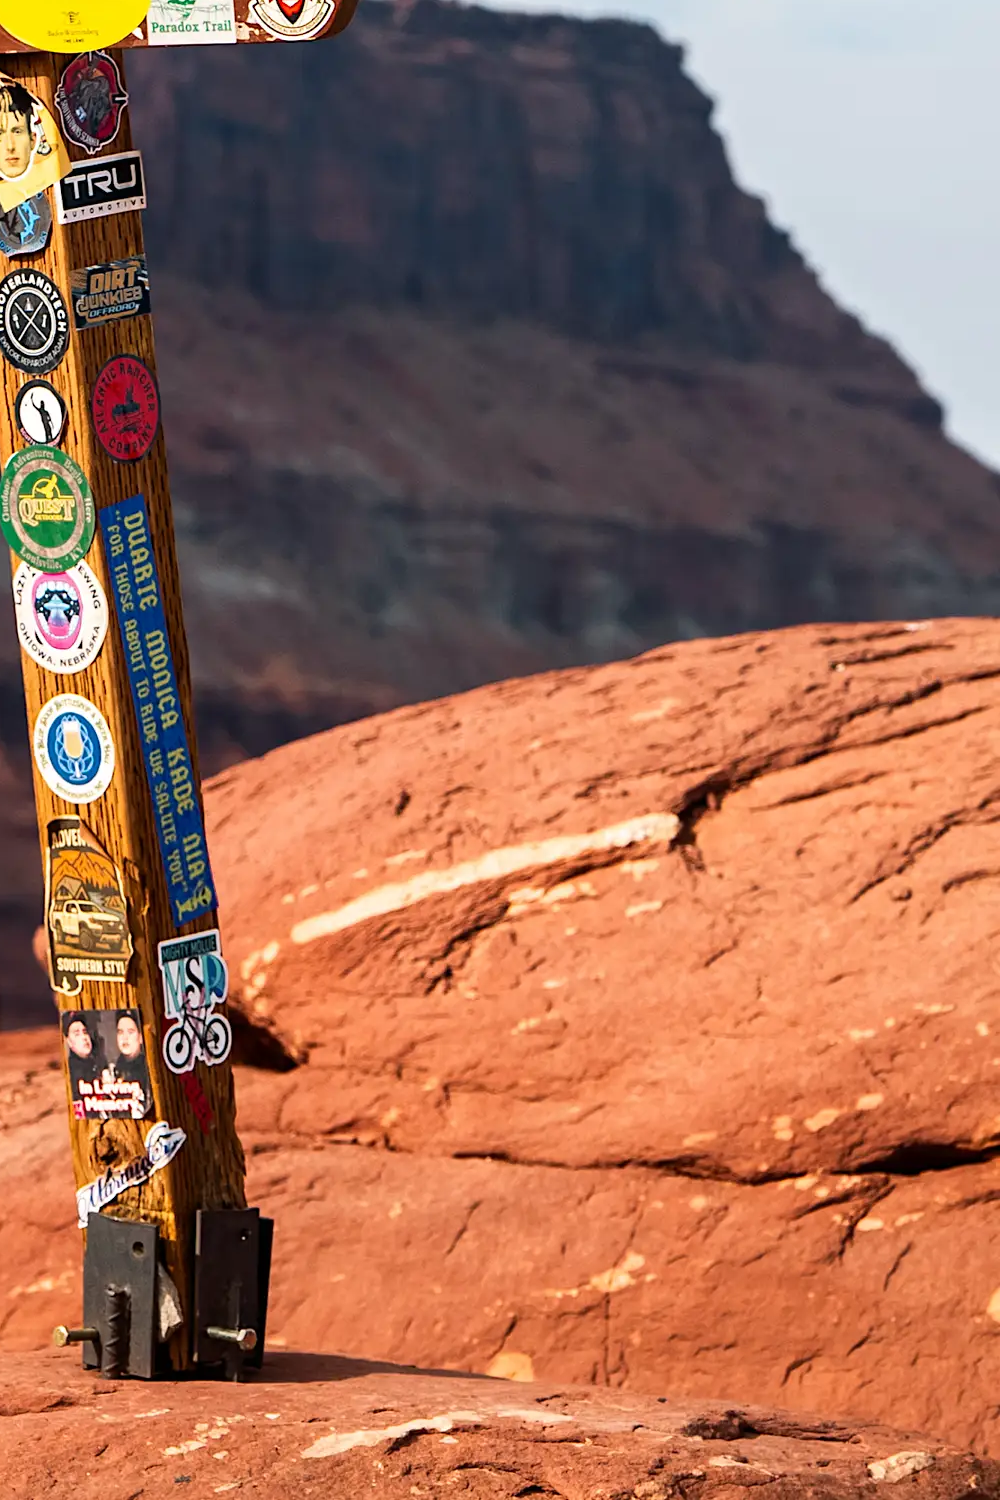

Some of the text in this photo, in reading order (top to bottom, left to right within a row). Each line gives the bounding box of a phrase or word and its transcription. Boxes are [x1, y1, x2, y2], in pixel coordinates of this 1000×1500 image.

[151, 20, 232, 33] Paradox Trail
[64, 164, 136, 199] TRU
[63, 199, 145, 219] AUTOMOTIVE
[89, 267, 137, 294] DIRT
[77, 286, 143, 315] JUNKIES
[88, 302, 137, 318] OFFROAD
[96, 361, 155, 433] ATLANTIC RANCHER
[108, 424, 154, 454] COMPANY
[2, 450, 92, 524] Outdoor Adventures Begin Here
[18, 498, 75, 527] QUEST
[71, 543, 85, 562] KY
[16, 574, 27, 606] LAZY
[78, 565, 101, 609] EWING
[114, 561, 135, 613] THOSE
[60, 626, 100, 667] NEBRASKA
[124, 618, 147, 672] ABOUT
[123, 510, 206, 879] DUARTE MONICA KADE NIA
[135, 677, 151, 698] TO
[140, 703, 158, 744] RIDE
[149, 748, 164, 777] WE
[155, 782, 177, 845] SALUTE
[57, 957, 103, 973] SOUTHERN
[162, 945, 189, 961] MIGHTY
[79, 1079, 93, 1095] In
